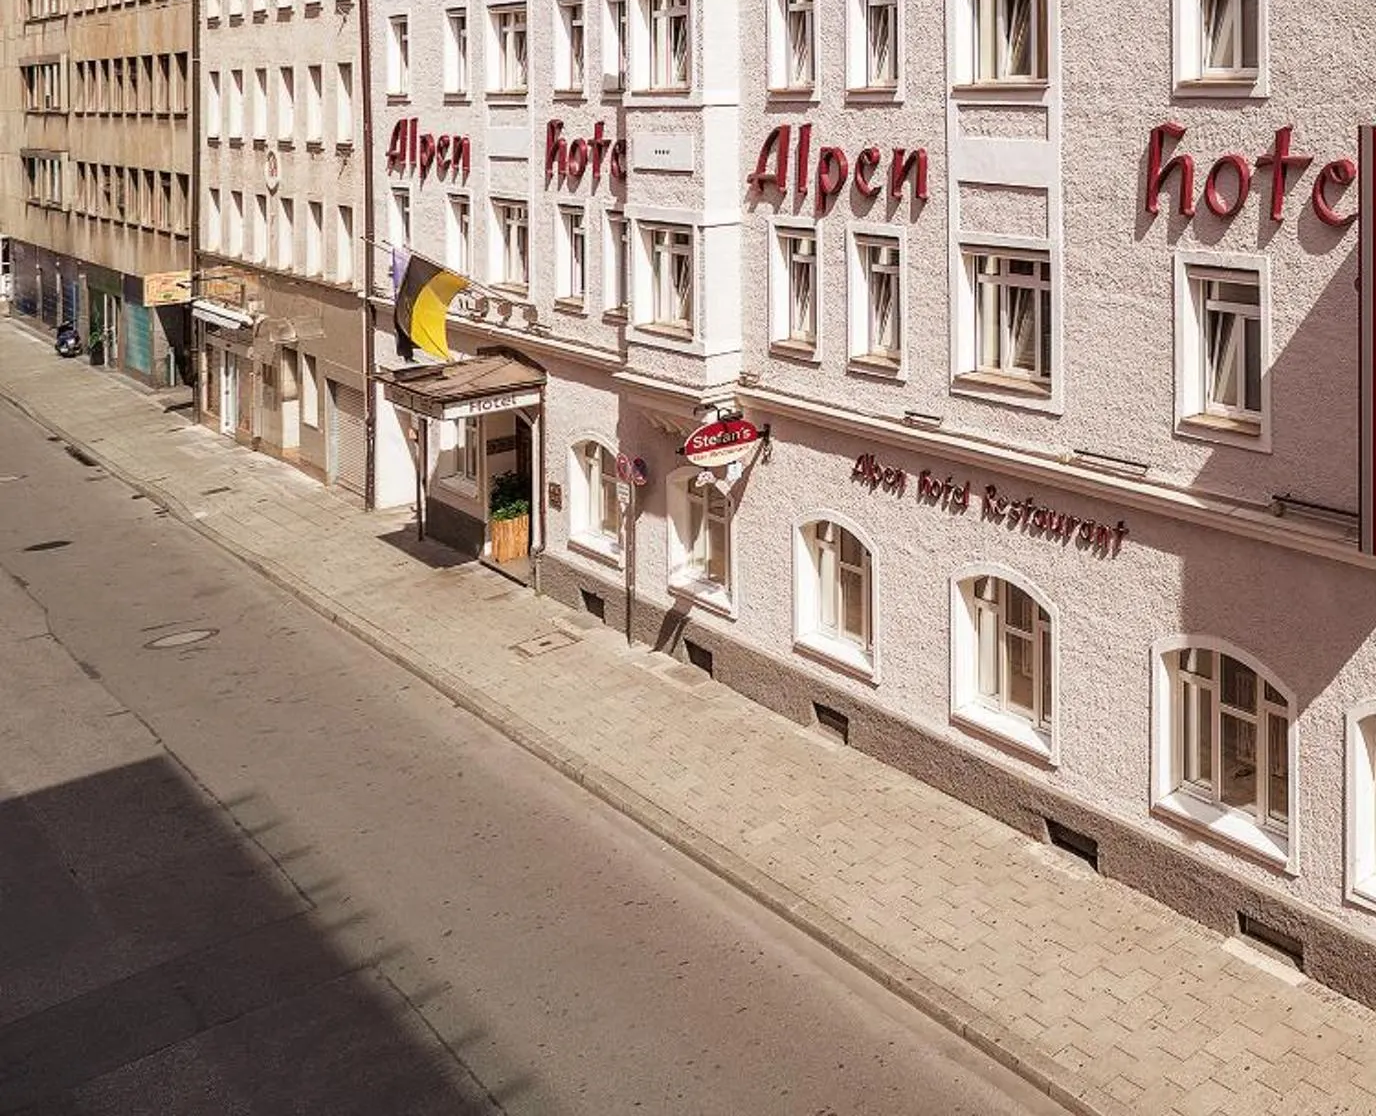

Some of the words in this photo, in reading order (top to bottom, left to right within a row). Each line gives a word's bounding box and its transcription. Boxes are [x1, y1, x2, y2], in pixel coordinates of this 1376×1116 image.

[386, 117, 470, 180] Alpen
[545, 119, 626, 181] hote
[747, 123, 927, 215] Alpen
[1146, 121, 1359, 226] hote
[692, 427, 753, 449] Stefan's
[852, 453, 906, 488] Alpen
[918, 468, 970, 508] hotel
[982, 484, 1129, 549] Restaurant
